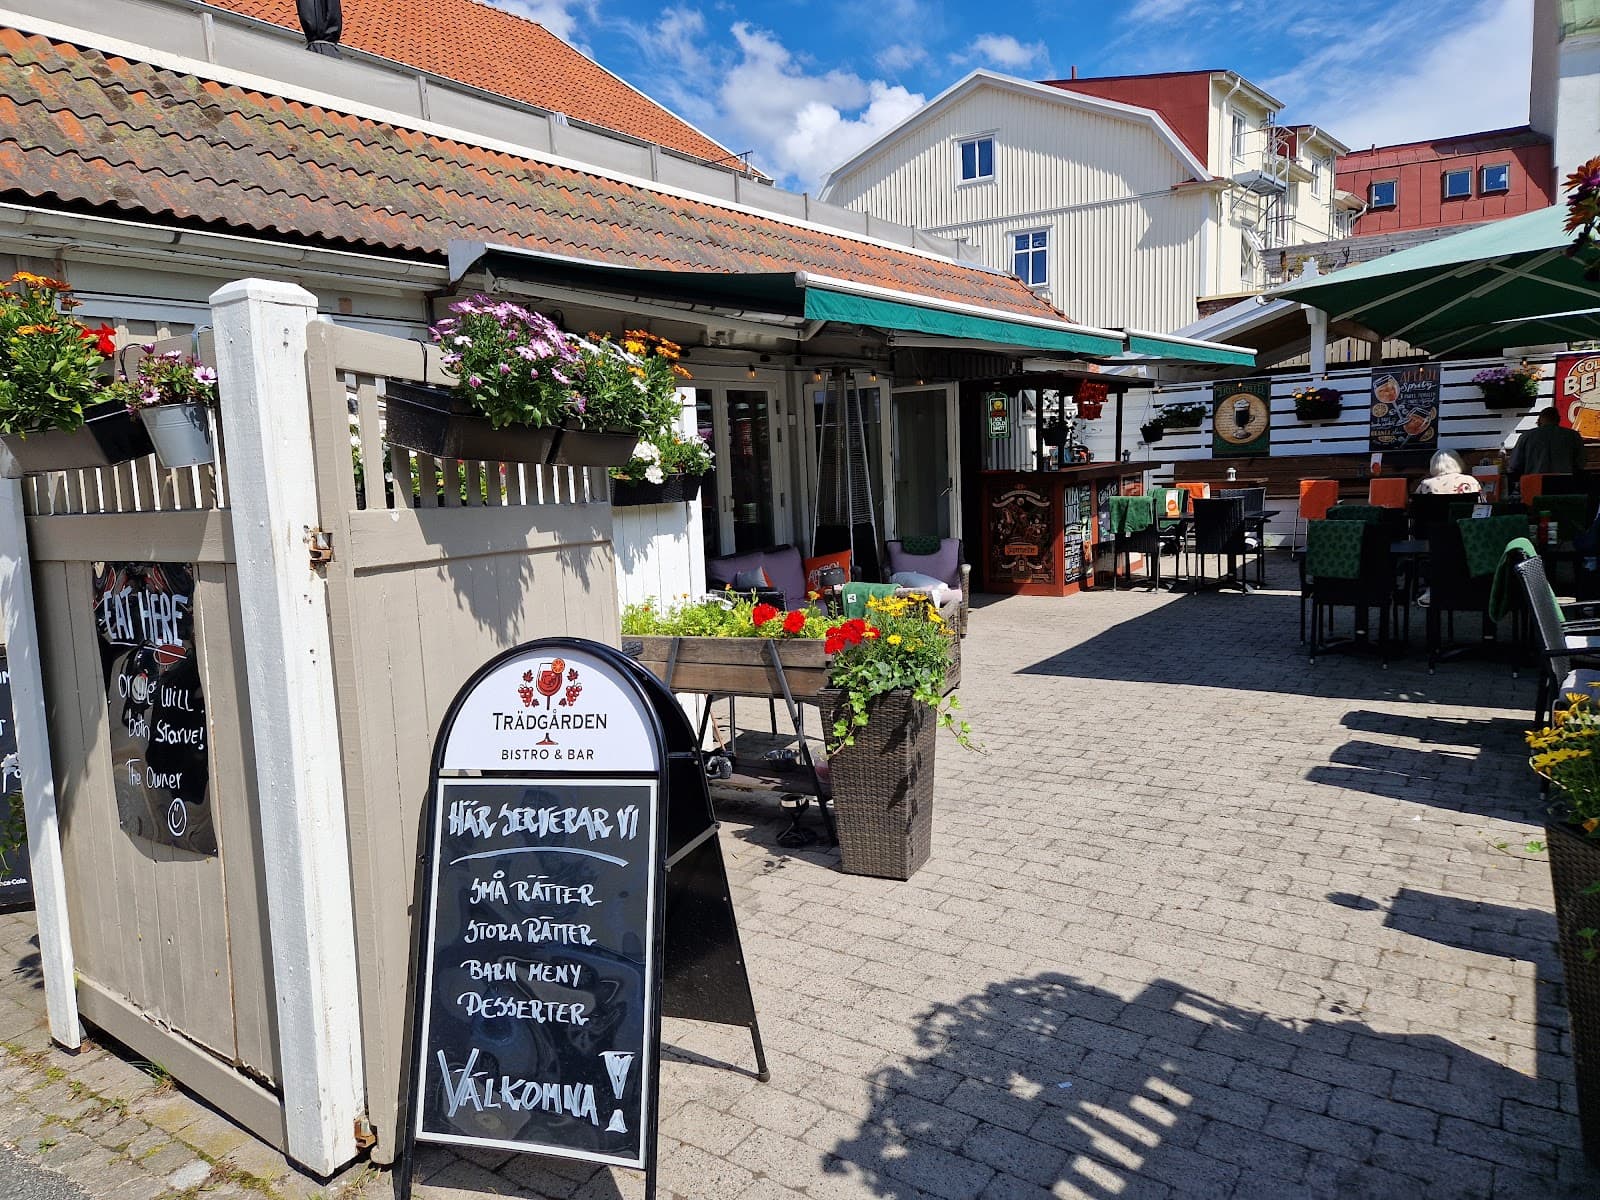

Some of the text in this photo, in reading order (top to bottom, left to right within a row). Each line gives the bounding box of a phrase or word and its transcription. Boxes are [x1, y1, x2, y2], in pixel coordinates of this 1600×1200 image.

[103, 586, 188, 646] EAT HERE
[493, 709, 607, 731] TRÄDGÅRDEN
[501, 749, 595, 760] BISTRO & BAR
[125, 758, 183, 790] The Owner
[448, 800, 498, 840] HÄR
[498, 801, 614, 842] SERVERAR
[469, 870, 509, 905] SMÅ
[463, 918, 523, 944] STORA
[460, 959, 582, 988] BARN MENY
[457, 991, 590, 1026] DESSERTER
